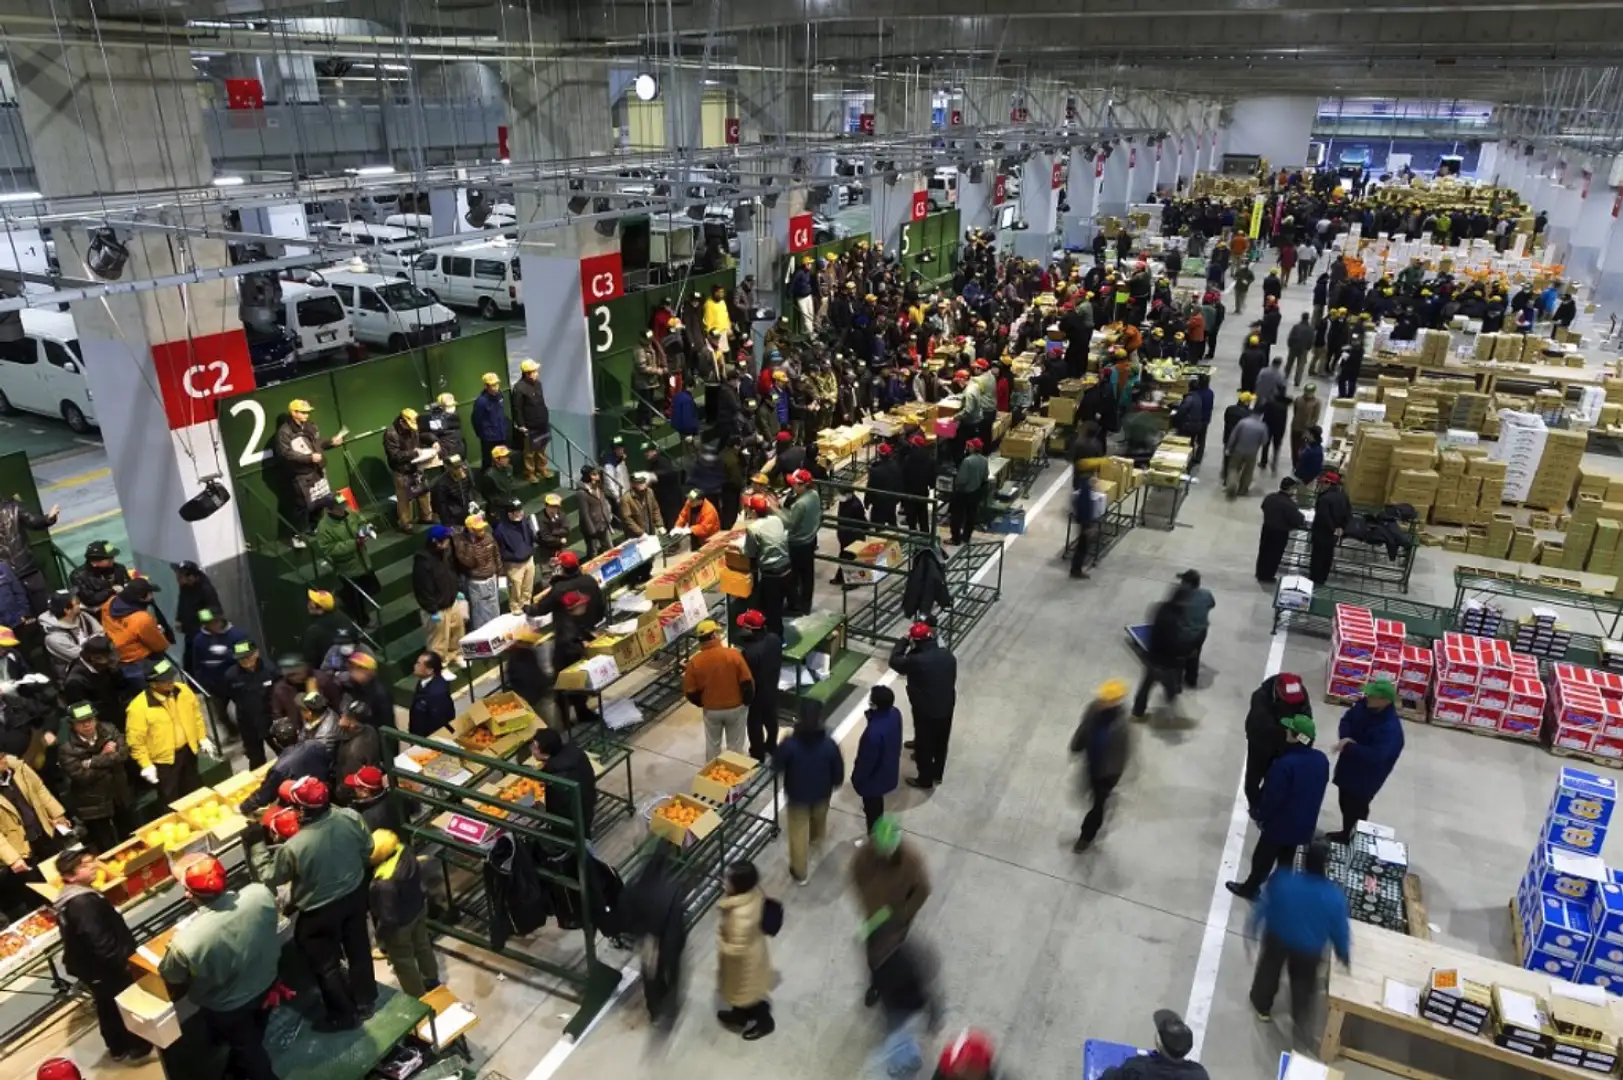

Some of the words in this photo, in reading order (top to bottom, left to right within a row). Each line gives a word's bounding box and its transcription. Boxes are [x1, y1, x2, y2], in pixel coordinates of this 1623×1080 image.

[794, 228, 809, 248] C4
[901, 223, 910, 255] 5
[592, 271, 615, 298] C3
[594, 305, 613, 353] 3
[182, 360, 234, 398] C2
[229, 399, 274, 467] 2
